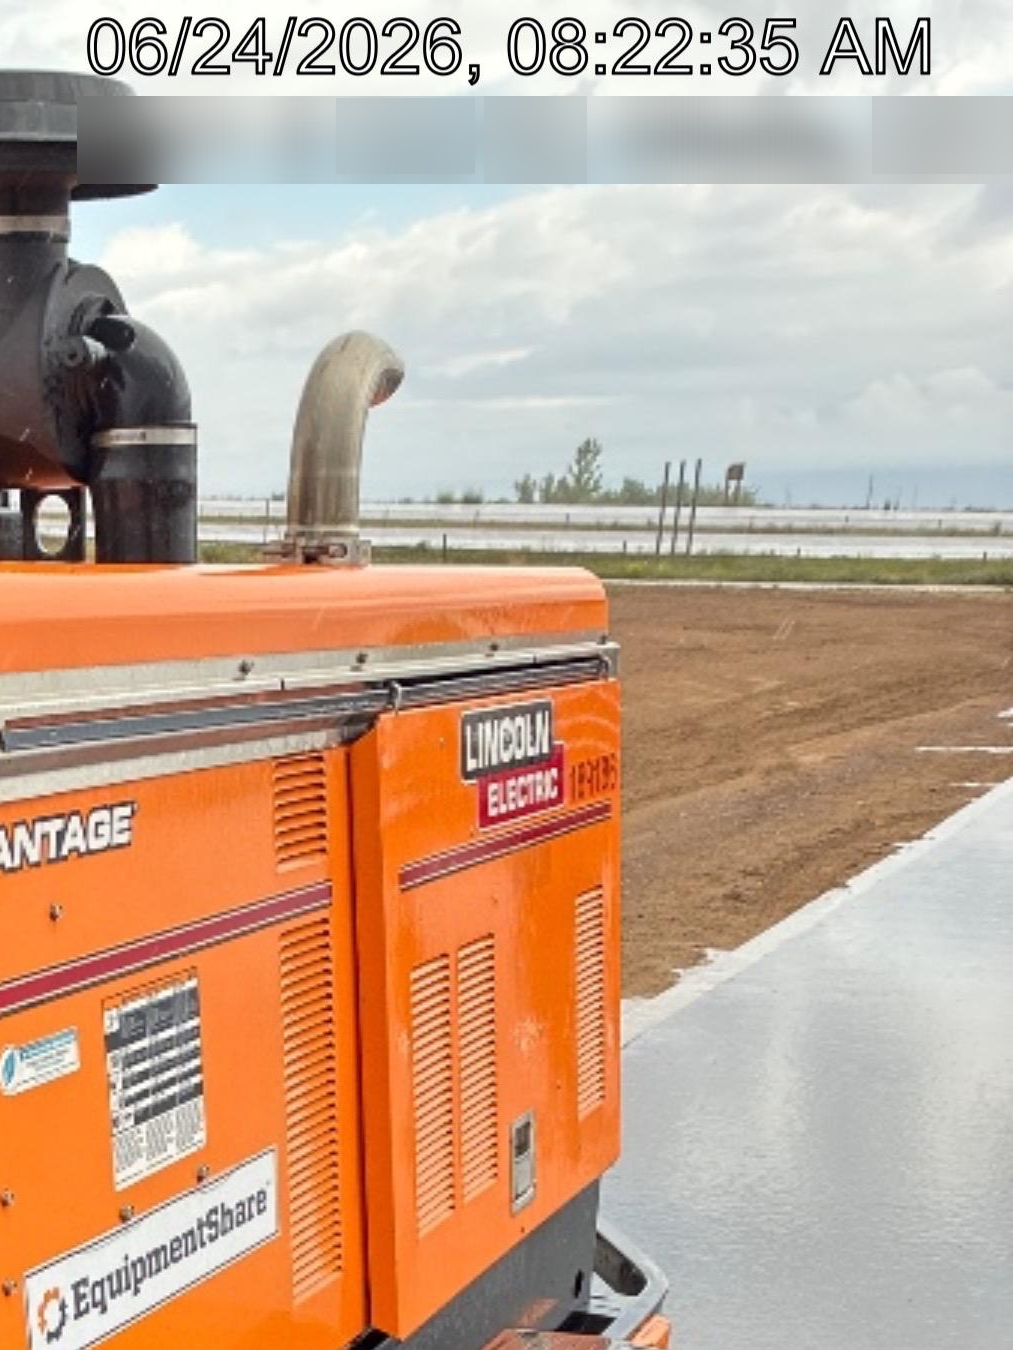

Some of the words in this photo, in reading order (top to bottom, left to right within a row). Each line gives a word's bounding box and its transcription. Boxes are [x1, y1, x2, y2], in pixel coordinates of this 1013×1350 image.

[465, 710, 550, 772] LINCOLN
[488, 767, 558, 817] ELECTRIC
[71, 1188, 268, 1321] EquipmentShare
